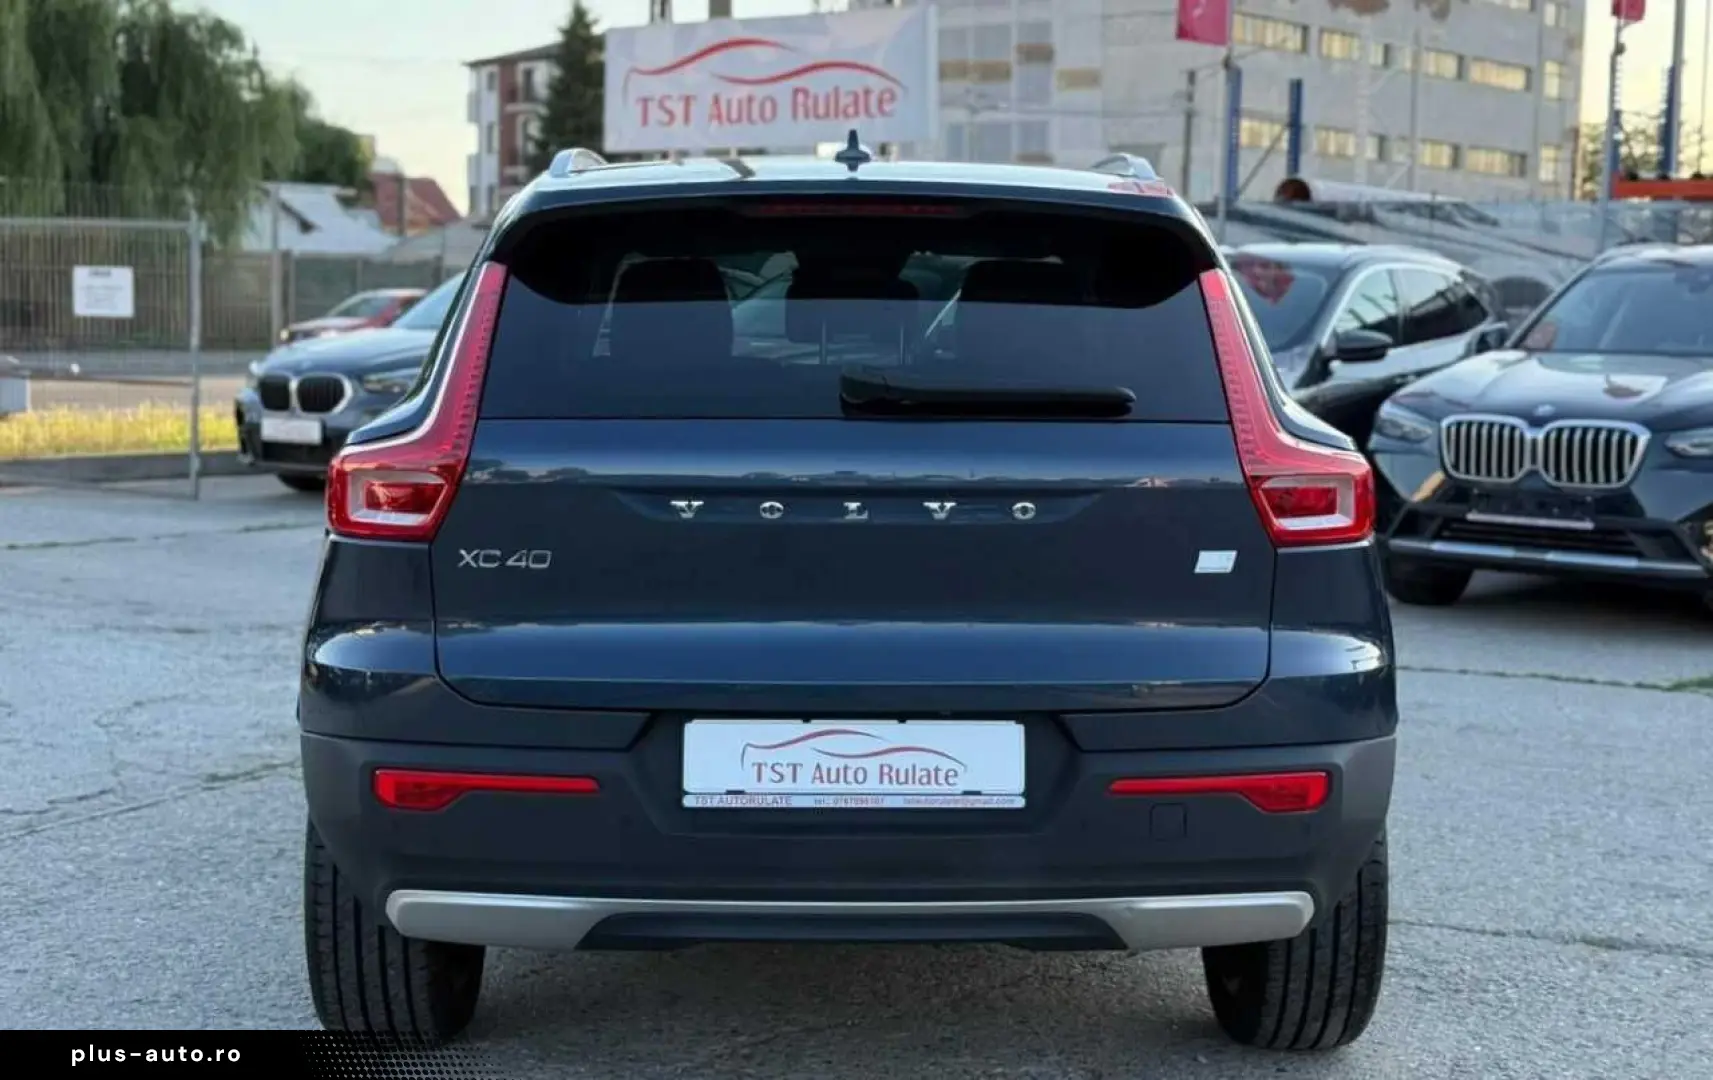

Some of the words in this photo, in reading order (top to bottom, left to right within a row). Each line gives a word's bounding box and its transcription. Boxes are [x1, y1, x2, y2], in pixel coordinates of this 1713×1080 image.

[636, 95, 697, 128] TST
[708, 93, 778, 127] Auto
[790, 86, 897, 121] Rulate
[670, 500, 1037, 520] VOLVO
[458, 549, 552, 568] XC40
[752, 762, 803, 784] TST
[811, 761, 868, 785] Auto
[879, 763, 958, 787] Rulate
